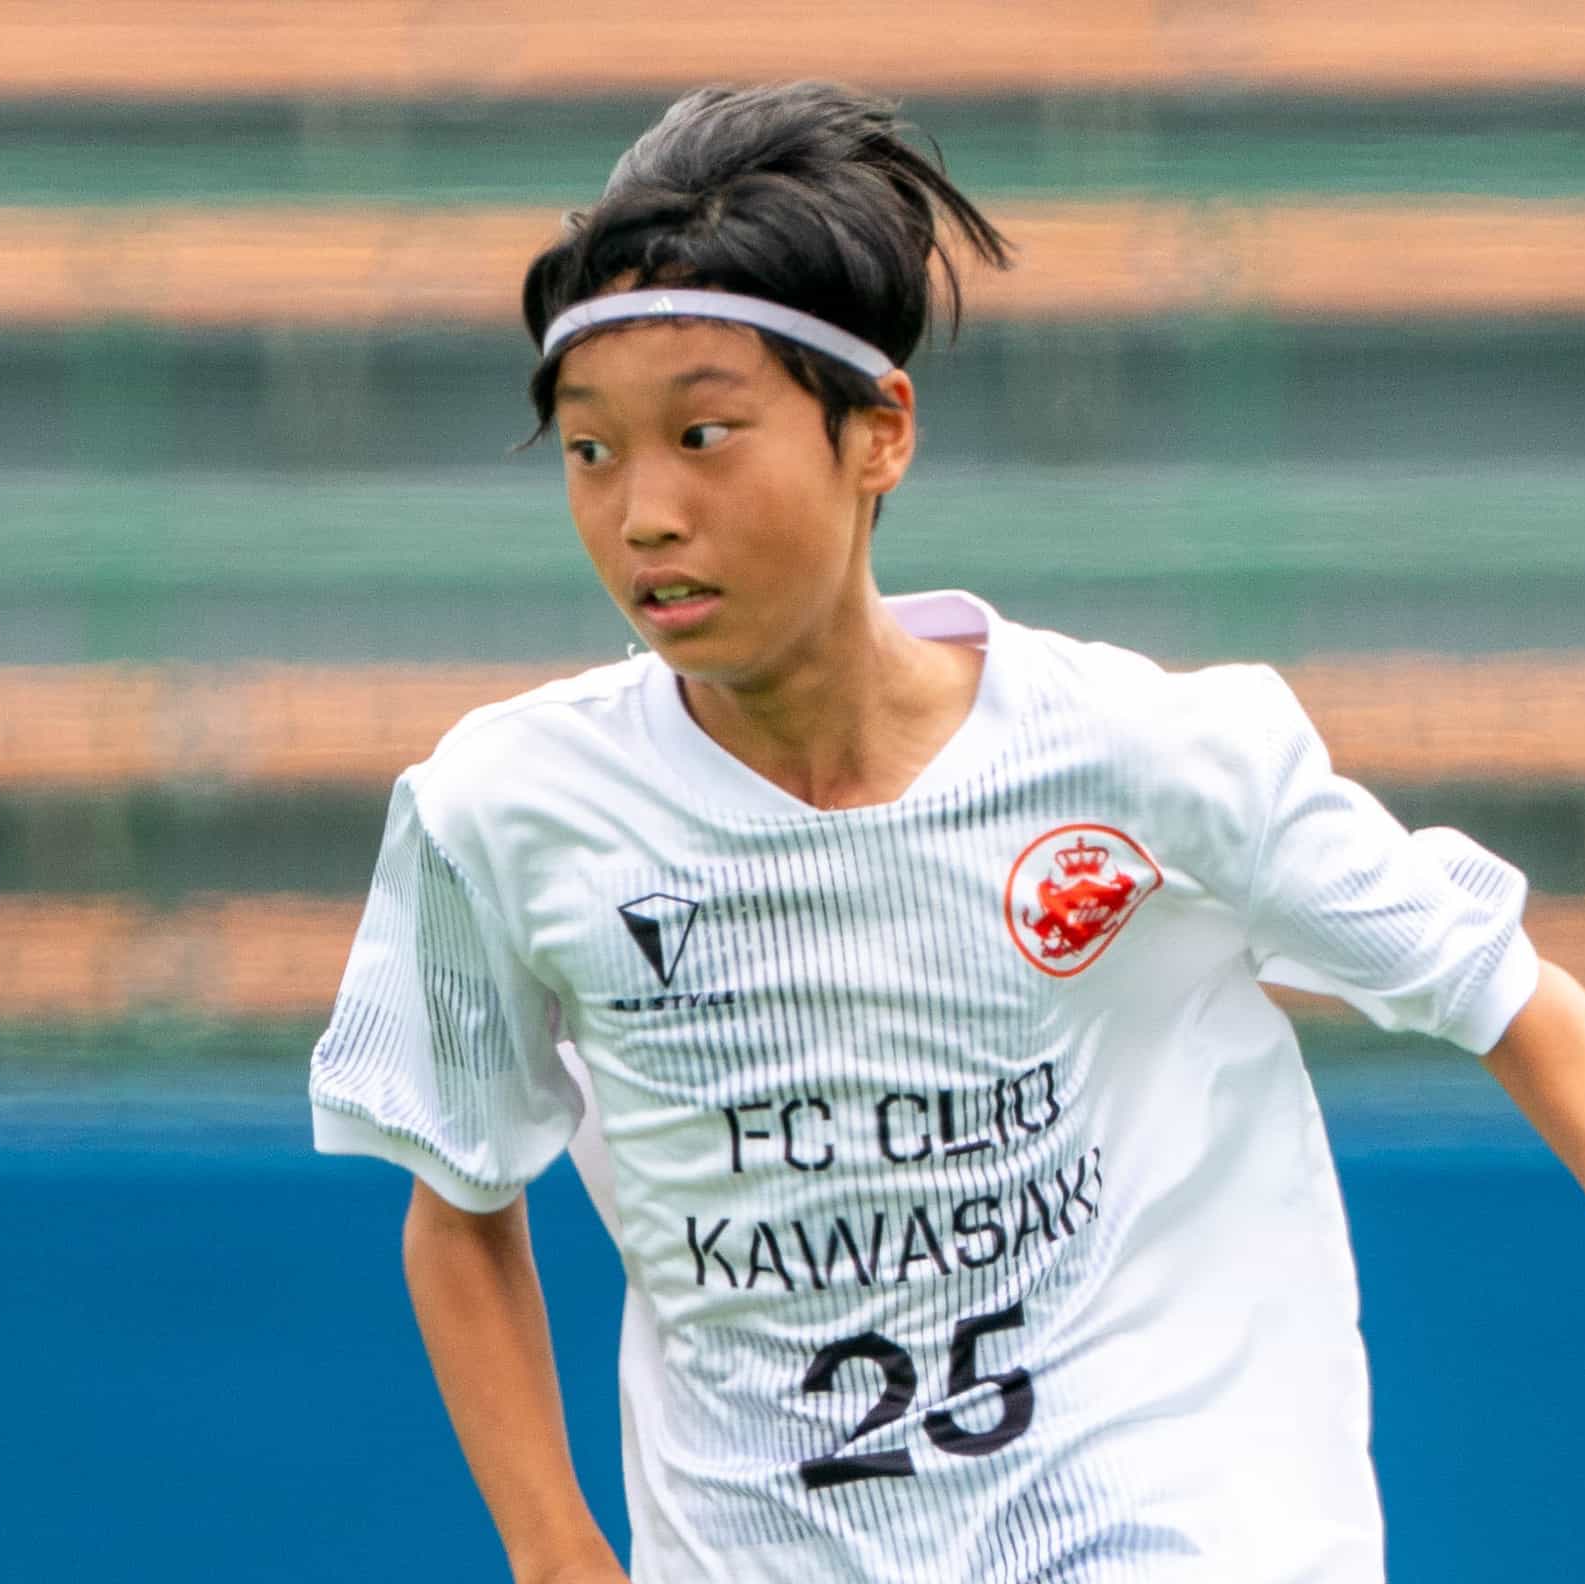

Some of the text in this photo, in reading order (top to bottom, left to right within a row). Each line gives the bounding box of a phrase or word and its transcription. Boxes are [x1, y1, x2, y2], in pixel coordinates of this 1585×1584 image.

[724, 1061, 1062, 1173] FC CLIO
[686, 1146, 1104, 1293] KAWASAKI
[799, 1299, 1036, 1491] 25
